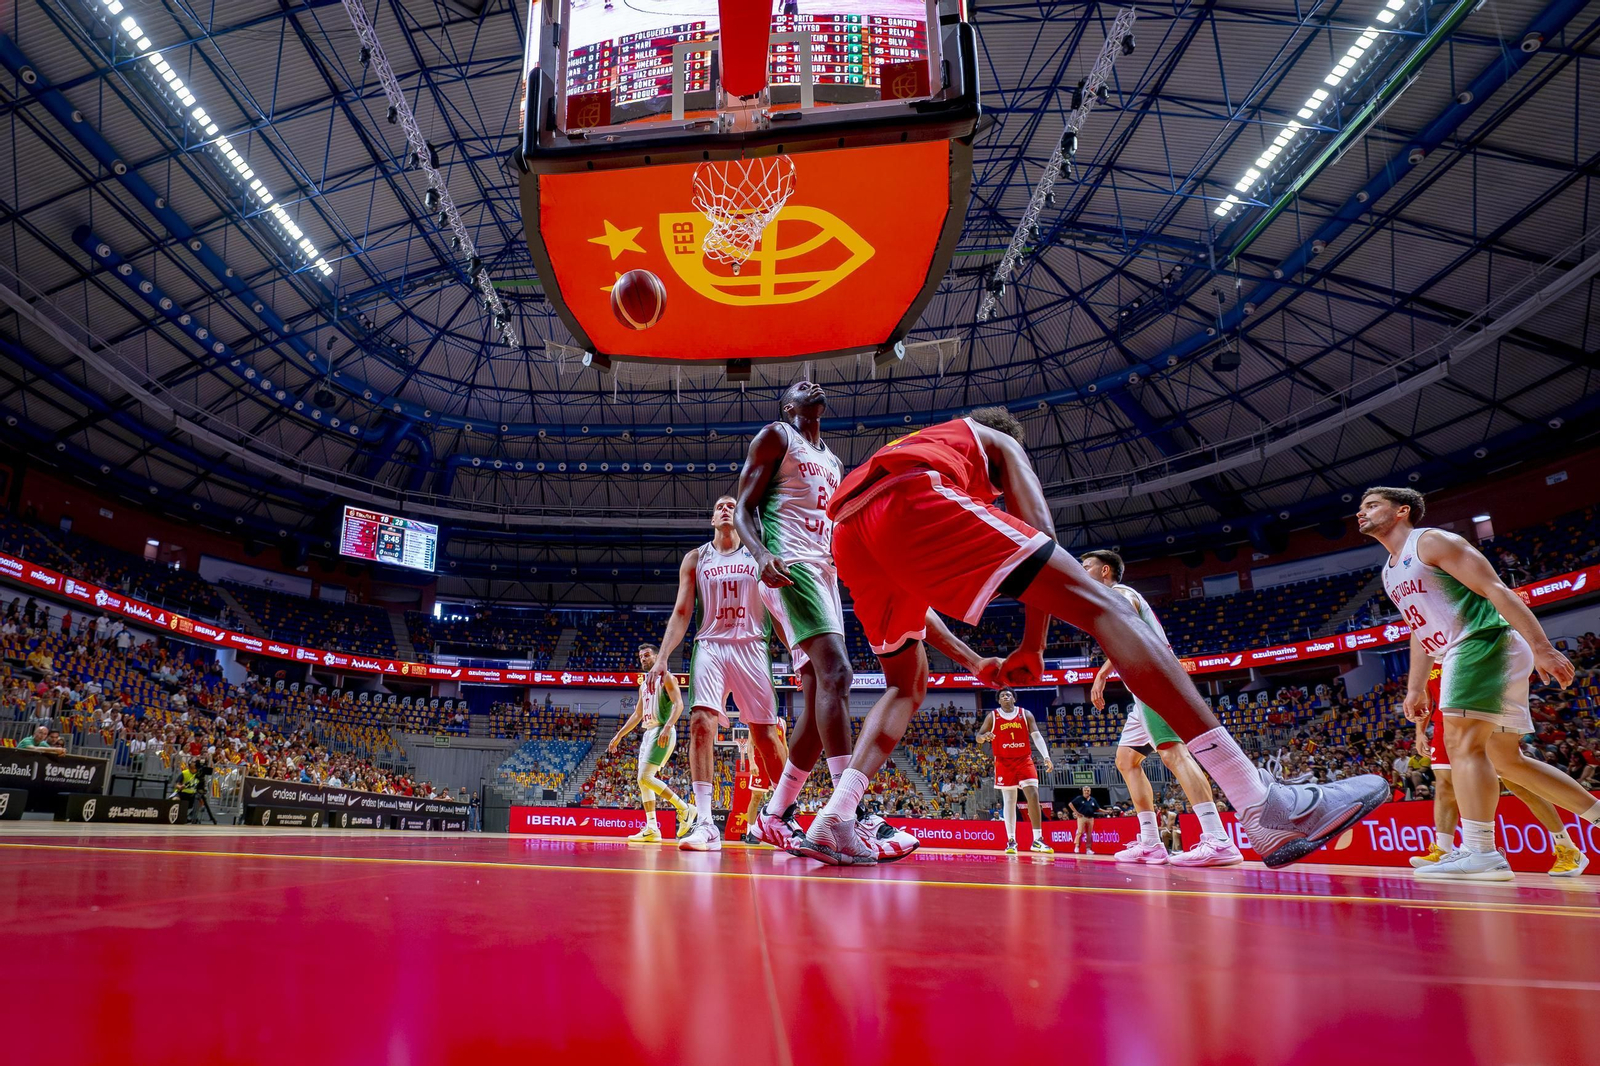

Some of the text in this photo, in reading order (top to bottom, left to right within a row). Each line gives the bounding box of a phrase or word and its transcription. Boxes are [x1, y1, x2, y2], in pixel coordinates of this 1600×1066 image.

[794, 14, 813, 22] BRITO
[888, 18, 917, 28] GAMEIRO
[635, 27, 673, 40] FOLGUEIRAS
[810, 34, 828, 42] TEIRO
[888, 38, 907, 46] SILVA
[635, 49, 657, 60] MILLER
[672, 221, 695, 254] FEB
[817, 485, 829, 510] 2
[384, 534, 400, 543] 8:45
[703, 564, 755, 580] PORTUGAL
[722, 580, 737, 598] 14
[1531, 580, 1572, 597] IBERIA
[194, 625, 216, 637] IBERIA
[1252, 647, 1297, 659] azulmarino
[1199, 657, 1230, 667] IBERIA
[429, 667, 452, 675] IBERIA
[1000, 722, 1022, 731] ESPAÑA
[1010, 732, 1015, 740] 1
[0, 762, 31, 777] xaBank
[272, 788, 296, 801] endesa
[108, 806, 158, 818] #LaFamilia
[527, 815, 661, 829] IBERIA Talento a boo
[911, 827, 995, 841] Talento a bordo
[1051, 831, 1073, 842] IBERIA
